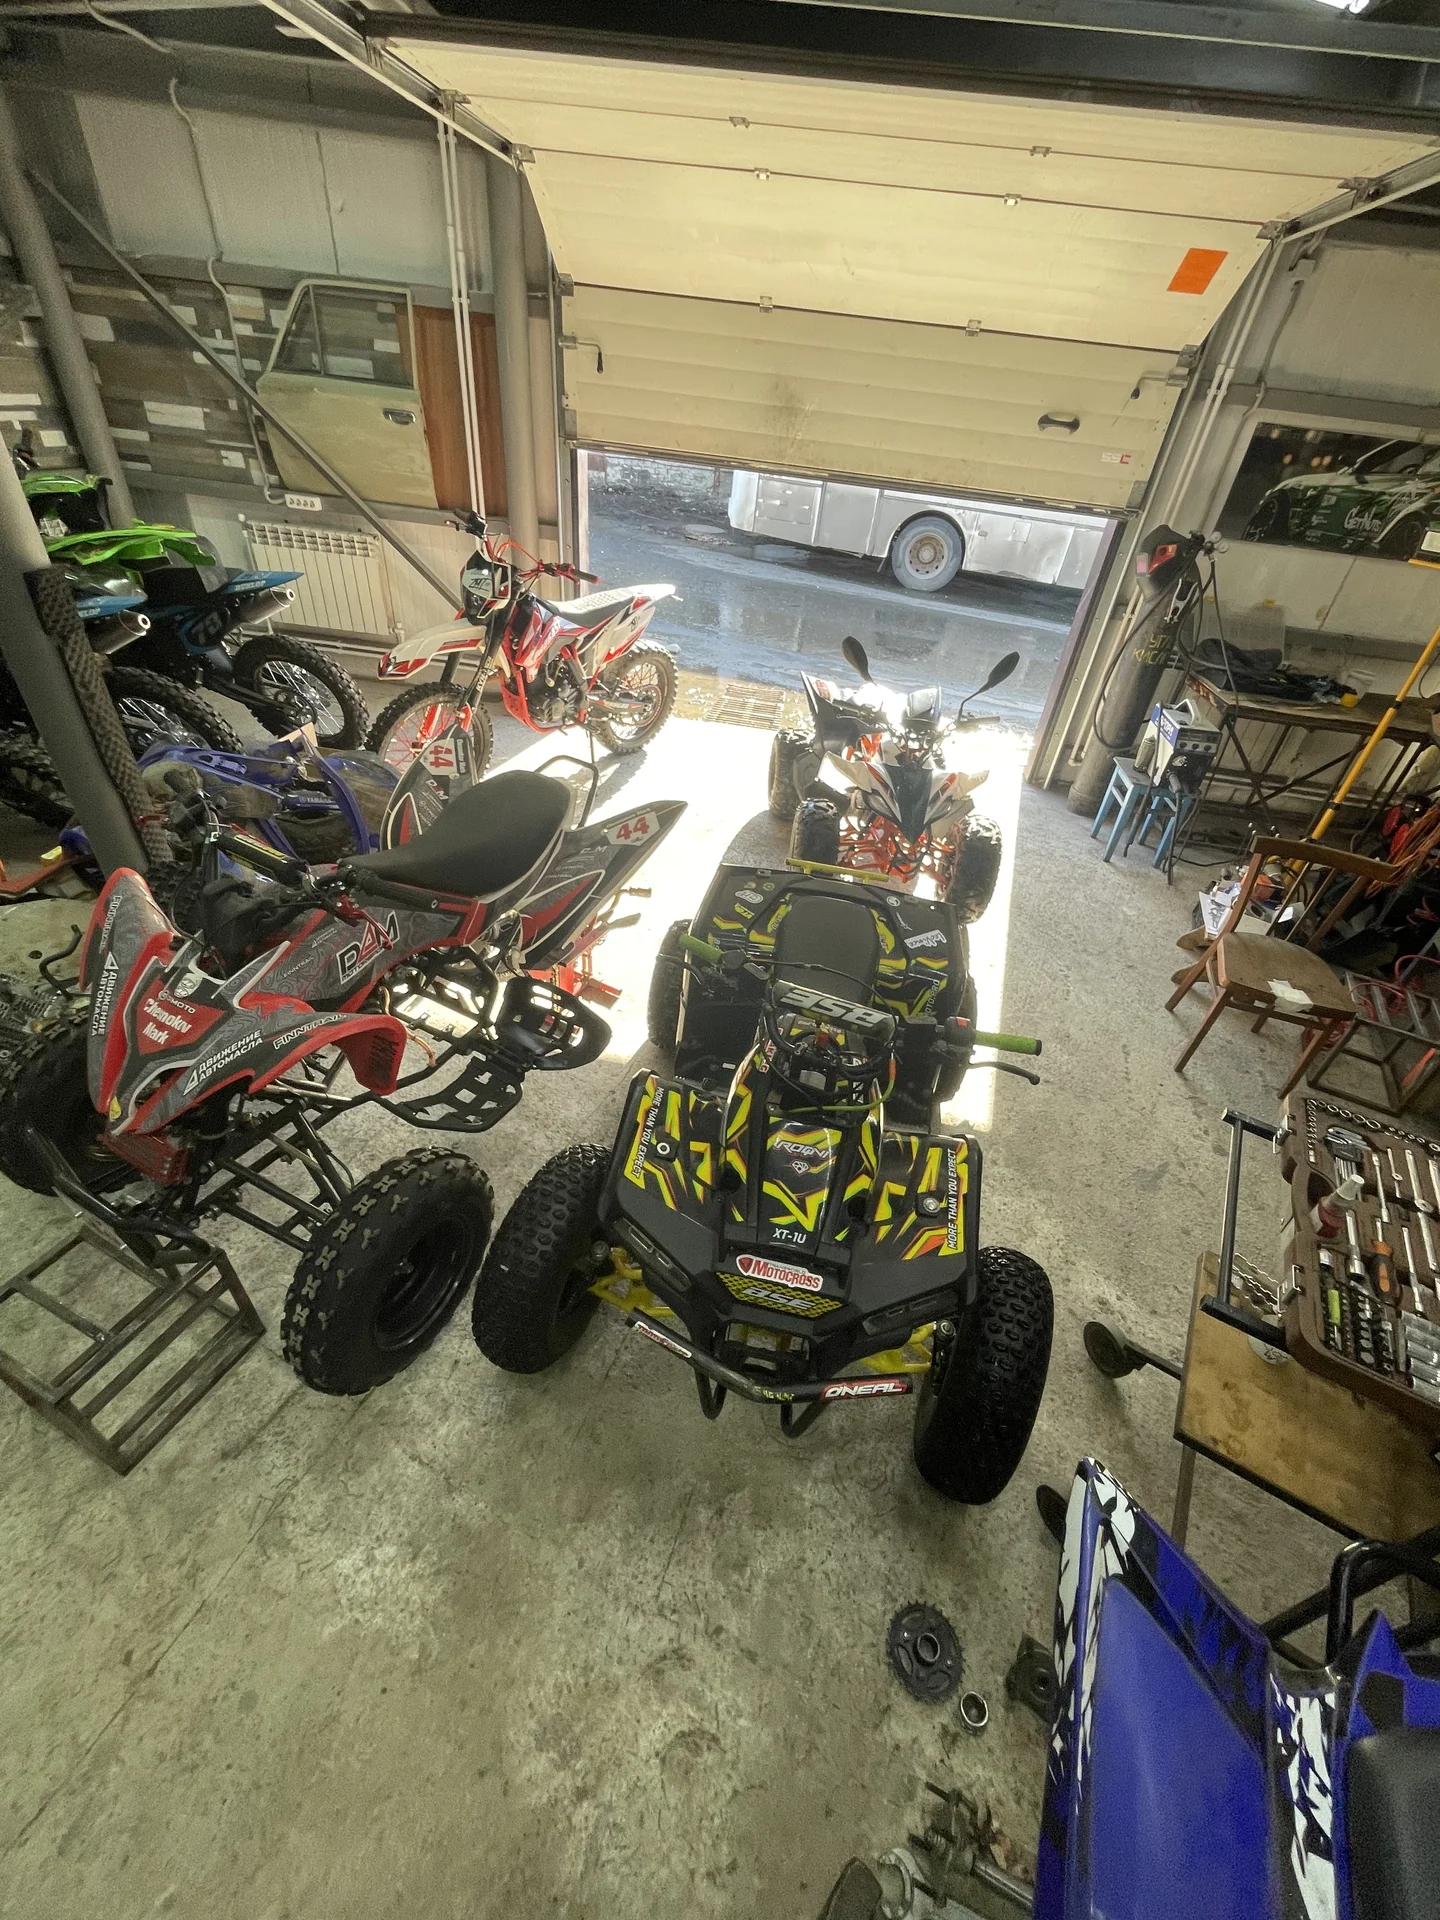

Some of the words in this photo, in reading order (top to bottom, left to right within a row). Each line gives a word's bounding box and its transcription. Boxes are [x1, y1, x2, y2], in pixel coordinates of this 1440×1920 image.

[429, 744, 454, 769] 44
[615, 816, 650, 841] 44
[91, 970, 109, 1037] АВТОМАСЛА
[97, 971, 118, 1036] ДВИЖЕНИЕ
[780, 987, 891, 1028] BSE
[142, 1021, 169, 1045] Mark
[199, 1030, 261, 1072] ДВИЖЕНИЕ
[200, 1037, 264, 1083] АВТОМАСЛА
[652, 1086, 665, 1107] MORE
[645, 1106, 659, 1128] THAN
[641, 1127, 653, 1145] YOU
[632, 1144, 648, 1178] EXPECT
[947, 1148, 957, 1178] EXPECT
[948, 1178, 957, 1196] YOU
[948, 1195, 958, 1220] THAN
[772, 1227, 807, 1244] XT-1U
[947, 1222, 958, 1250] MORE
[742, 1286, 817, 1310] BSE
